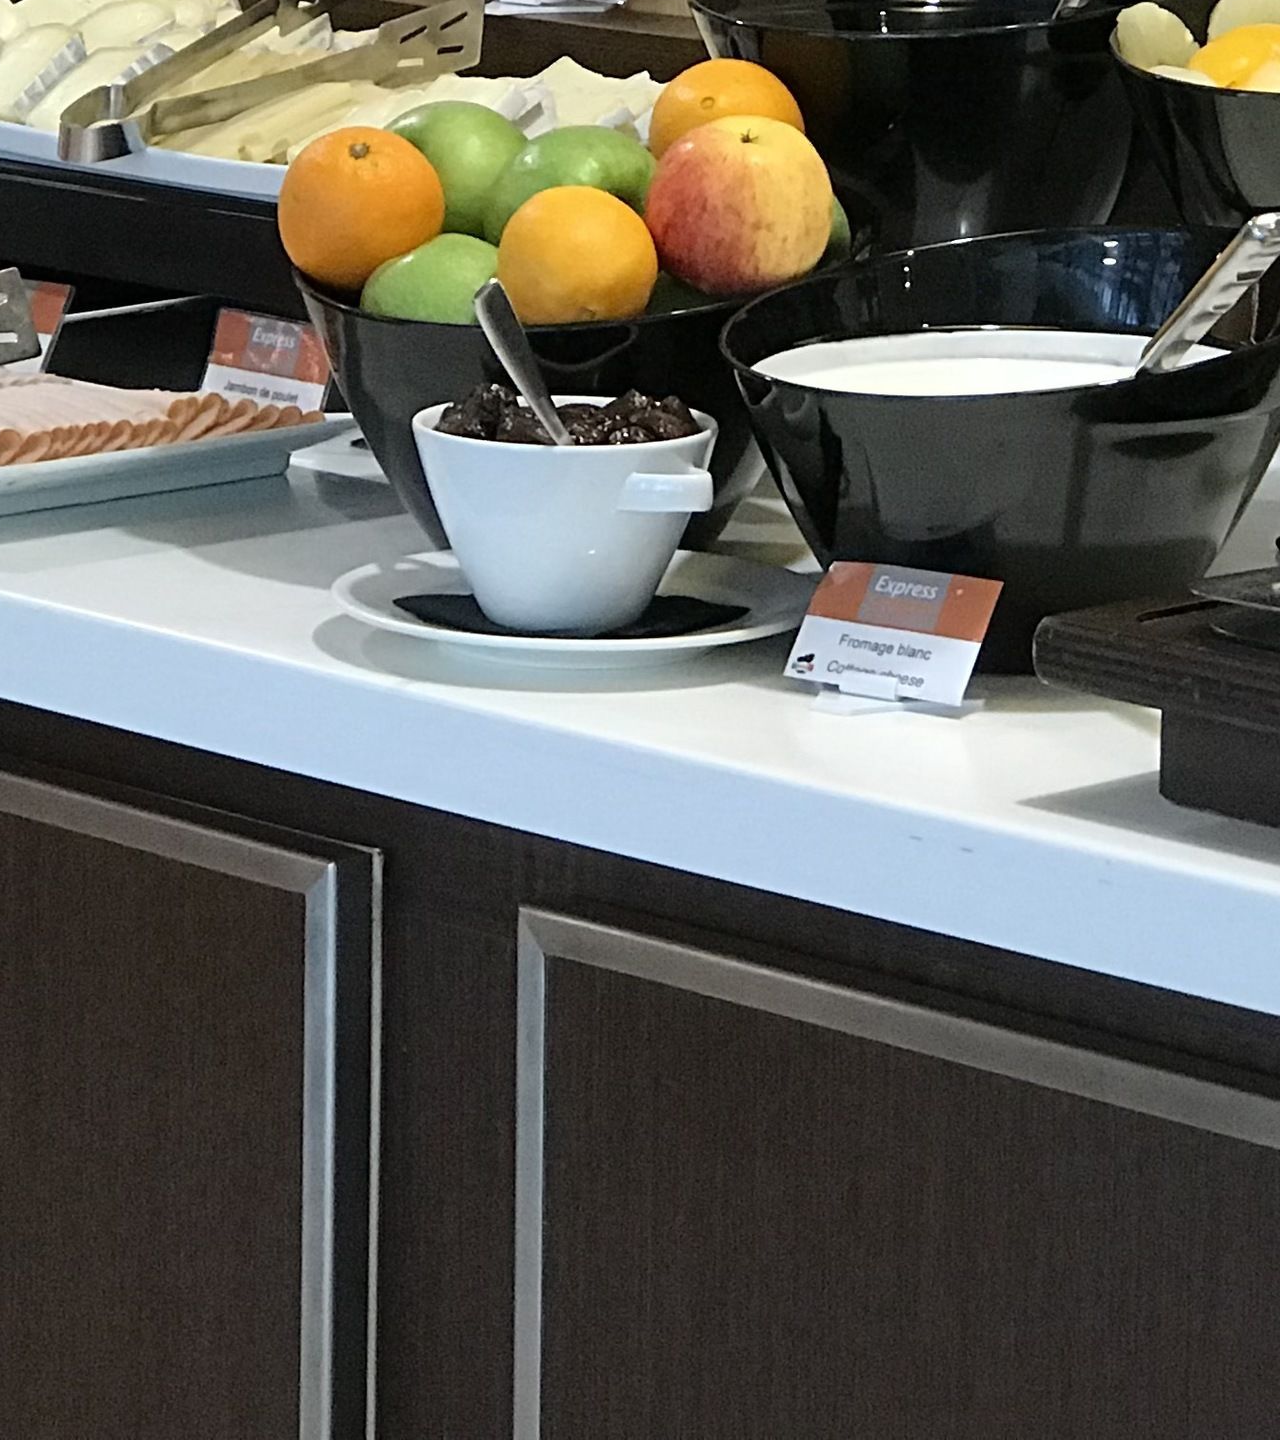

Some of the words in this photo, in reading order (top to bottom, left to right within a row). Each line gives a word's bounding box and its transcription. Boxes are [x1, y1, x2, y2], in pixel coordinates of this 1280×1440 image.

[252, 326, 295, 349] Express
[874, 575, 939, 600] Express
[838, 633, 894, 657] Fromage
[896, 643, 933, 661] blanc
